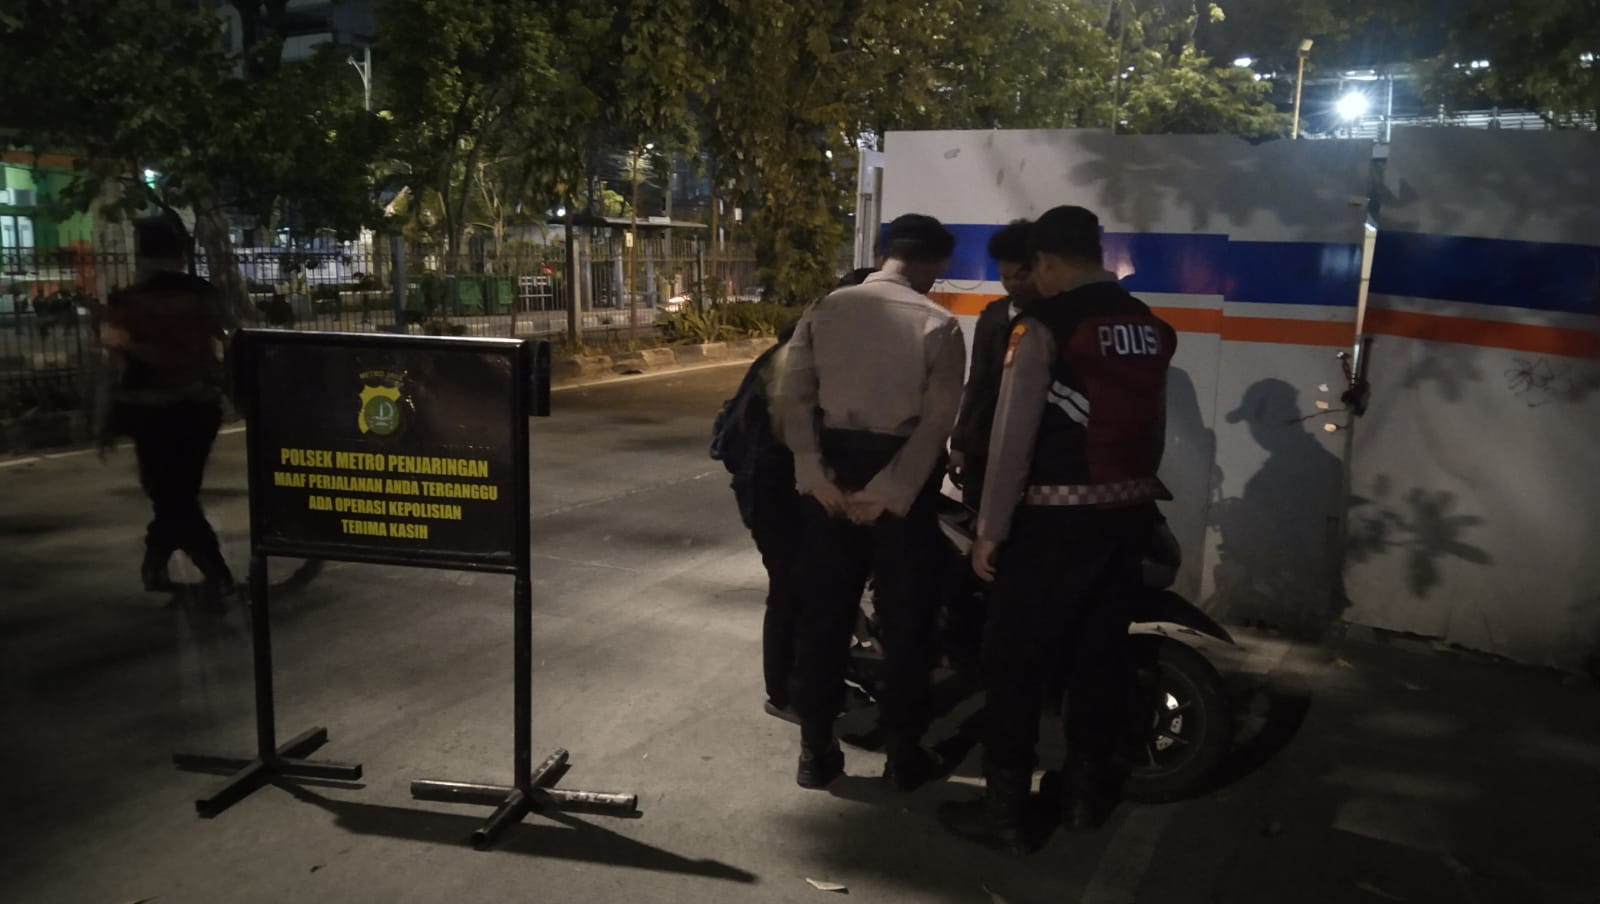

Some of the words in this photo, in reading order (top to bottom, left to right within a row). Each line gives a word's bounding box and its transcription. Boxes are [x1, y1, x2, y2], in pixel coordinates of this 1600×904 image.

[280, 448, 333, 468] POLSEK
[335, 451, 386, 472] METRO
[388, 454, 489, 478] PENJARINGAN
[273, 471, 307, 488] MAAF
[308, 474, 384, 493] PERJALANAN
[385, 479, 420, 496] ANDA
[421, 481, 498, 501] TERGANGGU
[308, 496, 333, 511] ADA
[335, 497, 386, 516] OPERASI
[389, 501, 463, 520] KEPOLISIAN
[341, 519, 387, 536] TERIMA
[389, 523, 429, 540] KASIH
